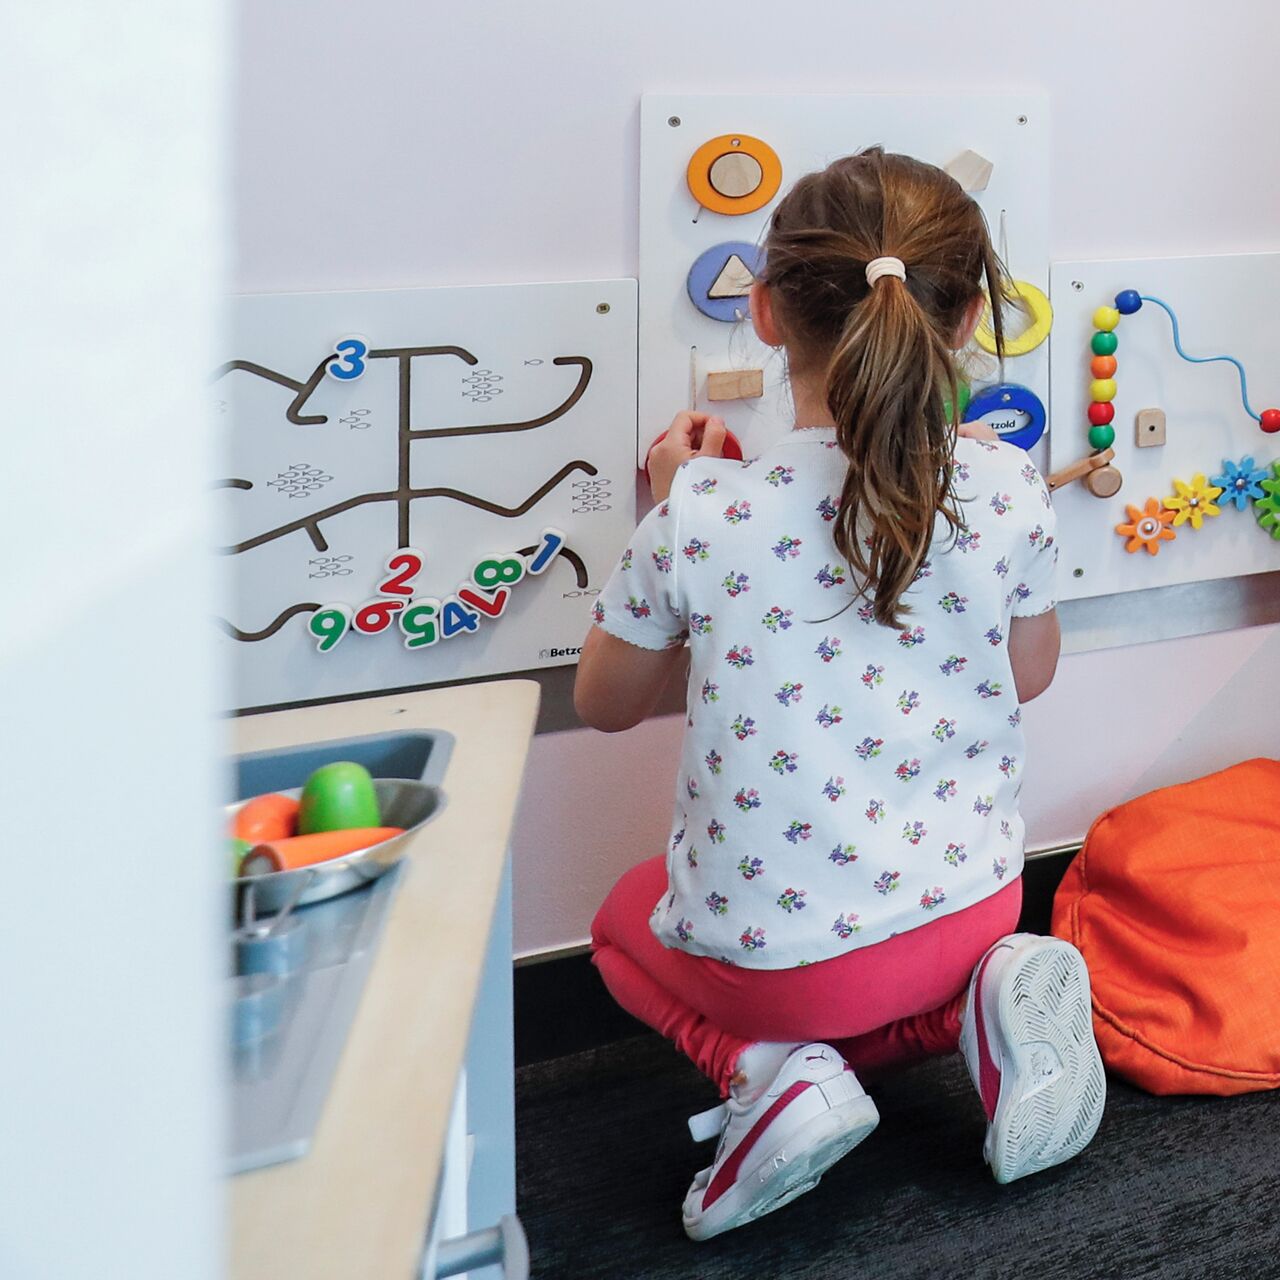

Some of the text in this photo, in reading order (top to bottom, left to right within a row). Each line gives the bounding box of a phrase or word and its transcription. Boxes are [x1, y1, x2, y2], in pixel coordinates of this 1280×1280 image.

[329, 339, 367, 380] 3
[379, 554, 422, 595] 2
[550, 647, 583, 657] Betzo
